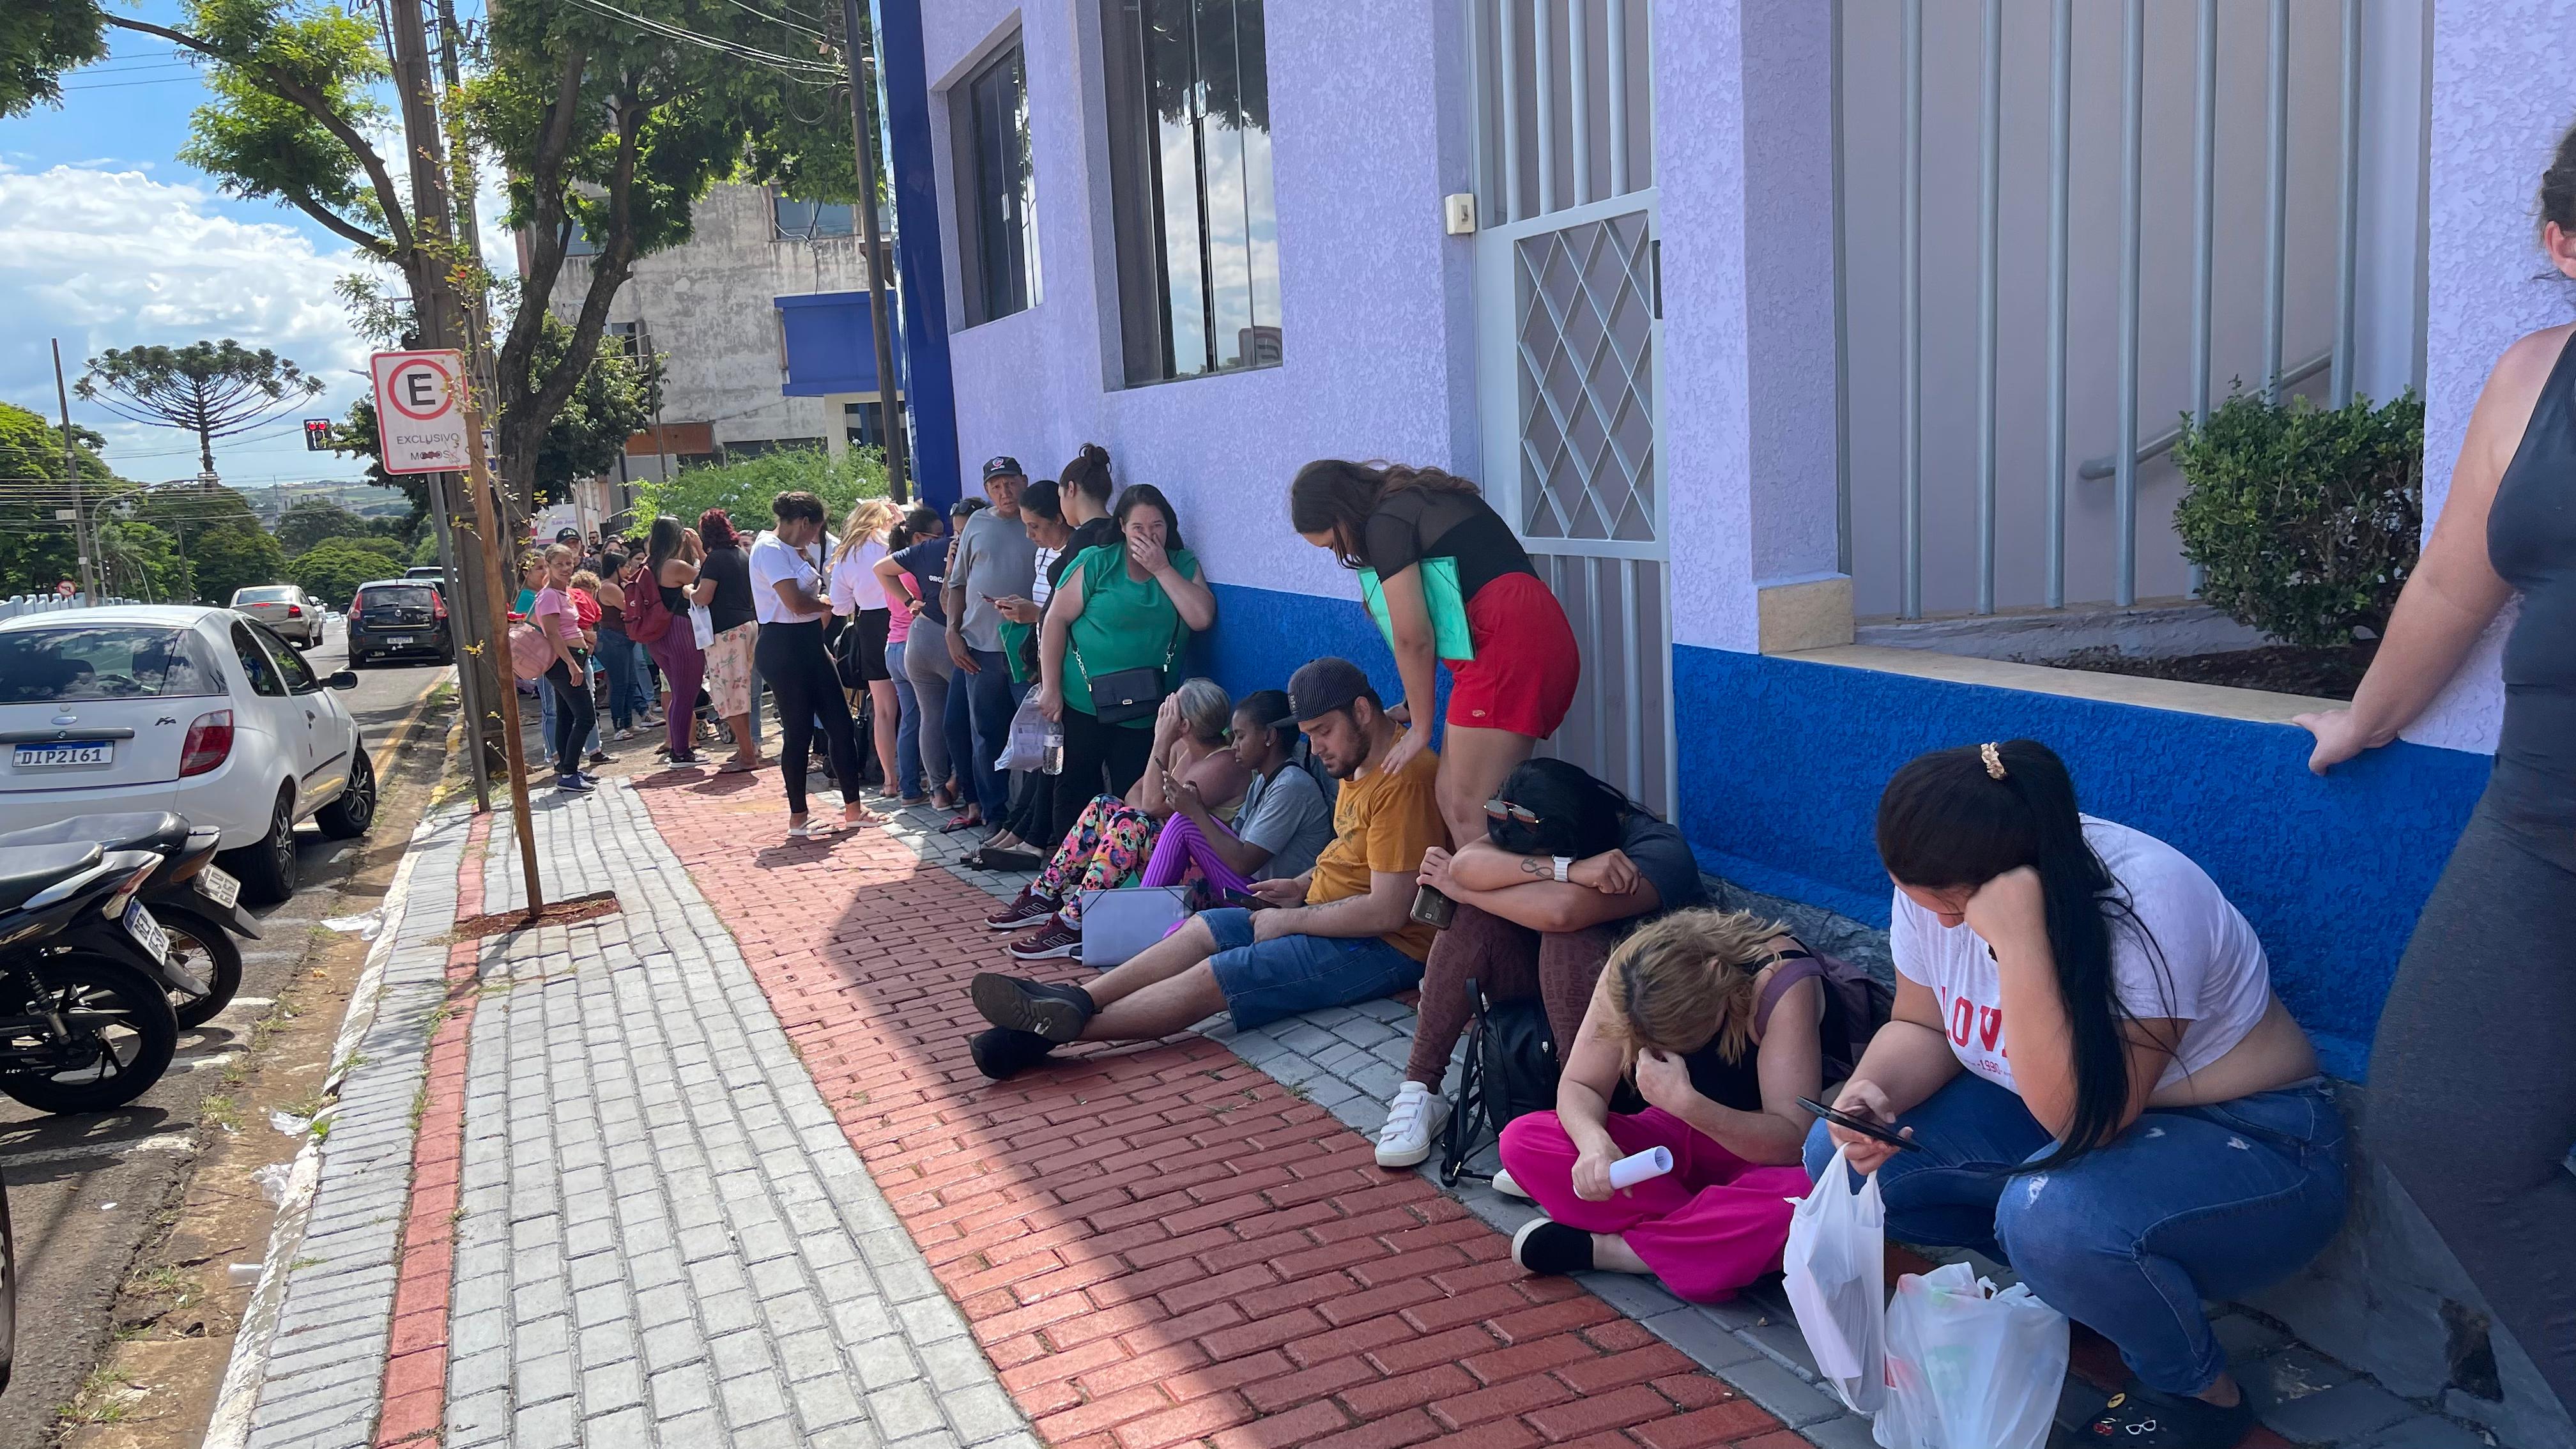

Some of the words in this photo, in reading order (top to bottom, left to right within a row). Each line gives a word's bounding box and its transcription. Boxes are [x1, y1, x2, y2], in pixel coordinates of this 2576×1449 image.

[407, 373, 436, 406] E
[397, 433, 459, 445] EXCLUSIVO
[1942, 986, 2008, 1057] OV
